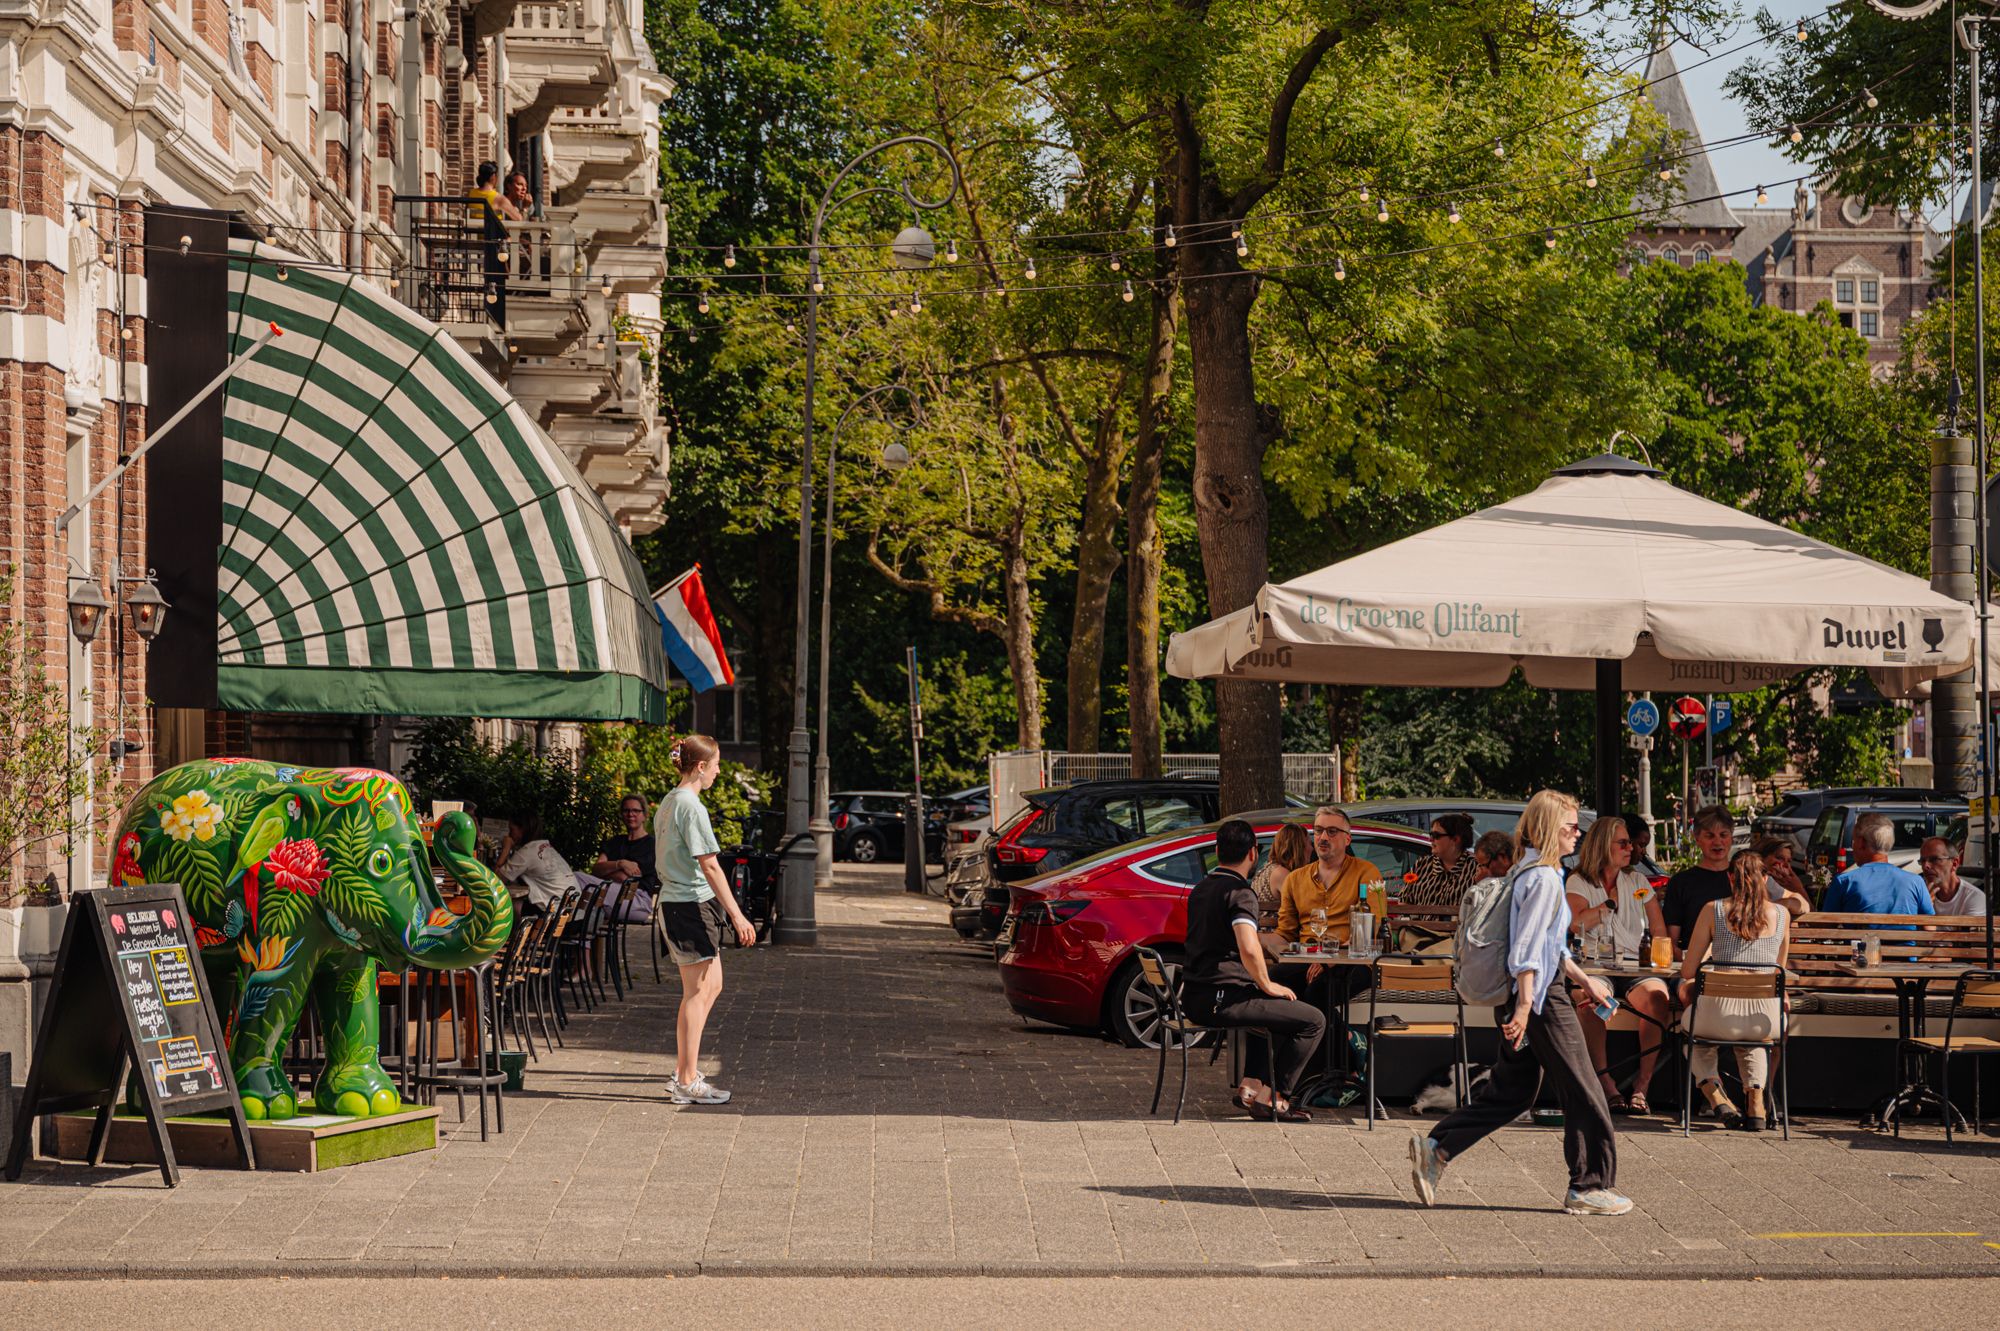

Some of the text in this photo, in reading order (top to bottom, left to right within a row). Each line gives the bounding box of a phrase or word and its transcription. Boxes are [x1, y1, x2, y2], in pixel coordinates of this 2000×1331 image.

[1300, 595, 1522, 638] de Groene Olifant
[1822, 617, 1907, 650] Duvel
[1717, 710, 1726, 724] P
[153, 922, 161, 936] bij
[122, 940, 131, 951] De
[132, 938, 156, 950] Groene
[127, 959, 142, 978] Hey
[138, 1011, 164, 1027] biertje
